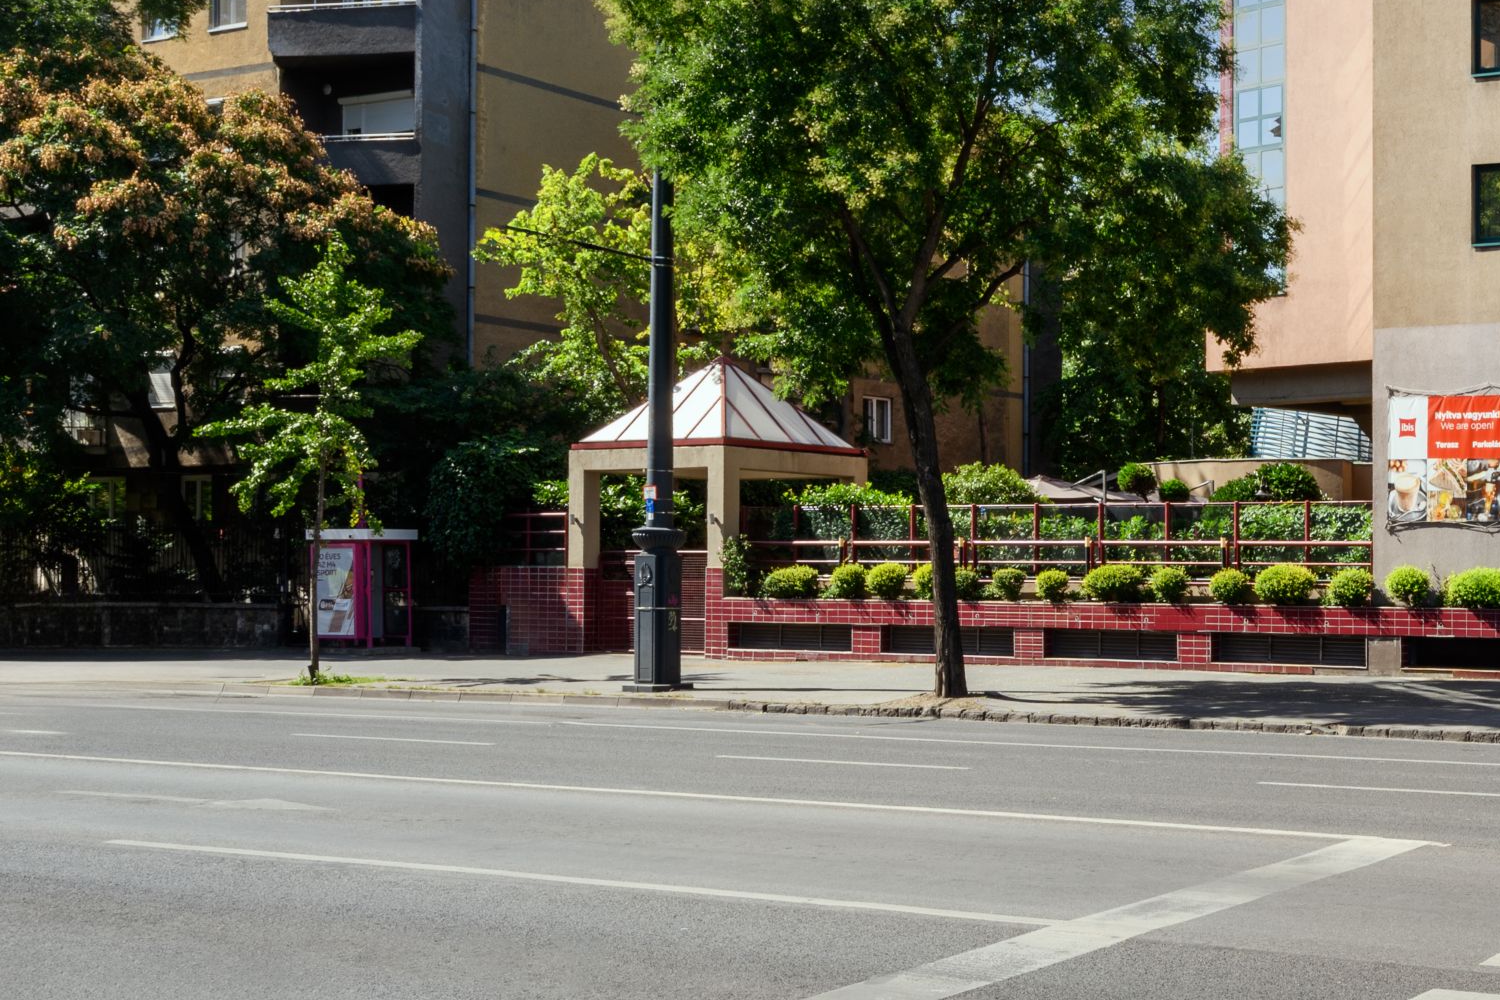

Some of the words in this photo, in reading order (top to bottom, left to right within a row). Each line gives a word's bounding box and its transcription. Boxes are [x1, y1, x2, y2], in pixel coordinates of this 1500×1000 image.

[1435, 411, 1462, 421] Nyitva
[1401, 422, 1415, 432] ibis
[1440, 422, 1455, 430] We
[1471, 422, 1495, 431] open!
